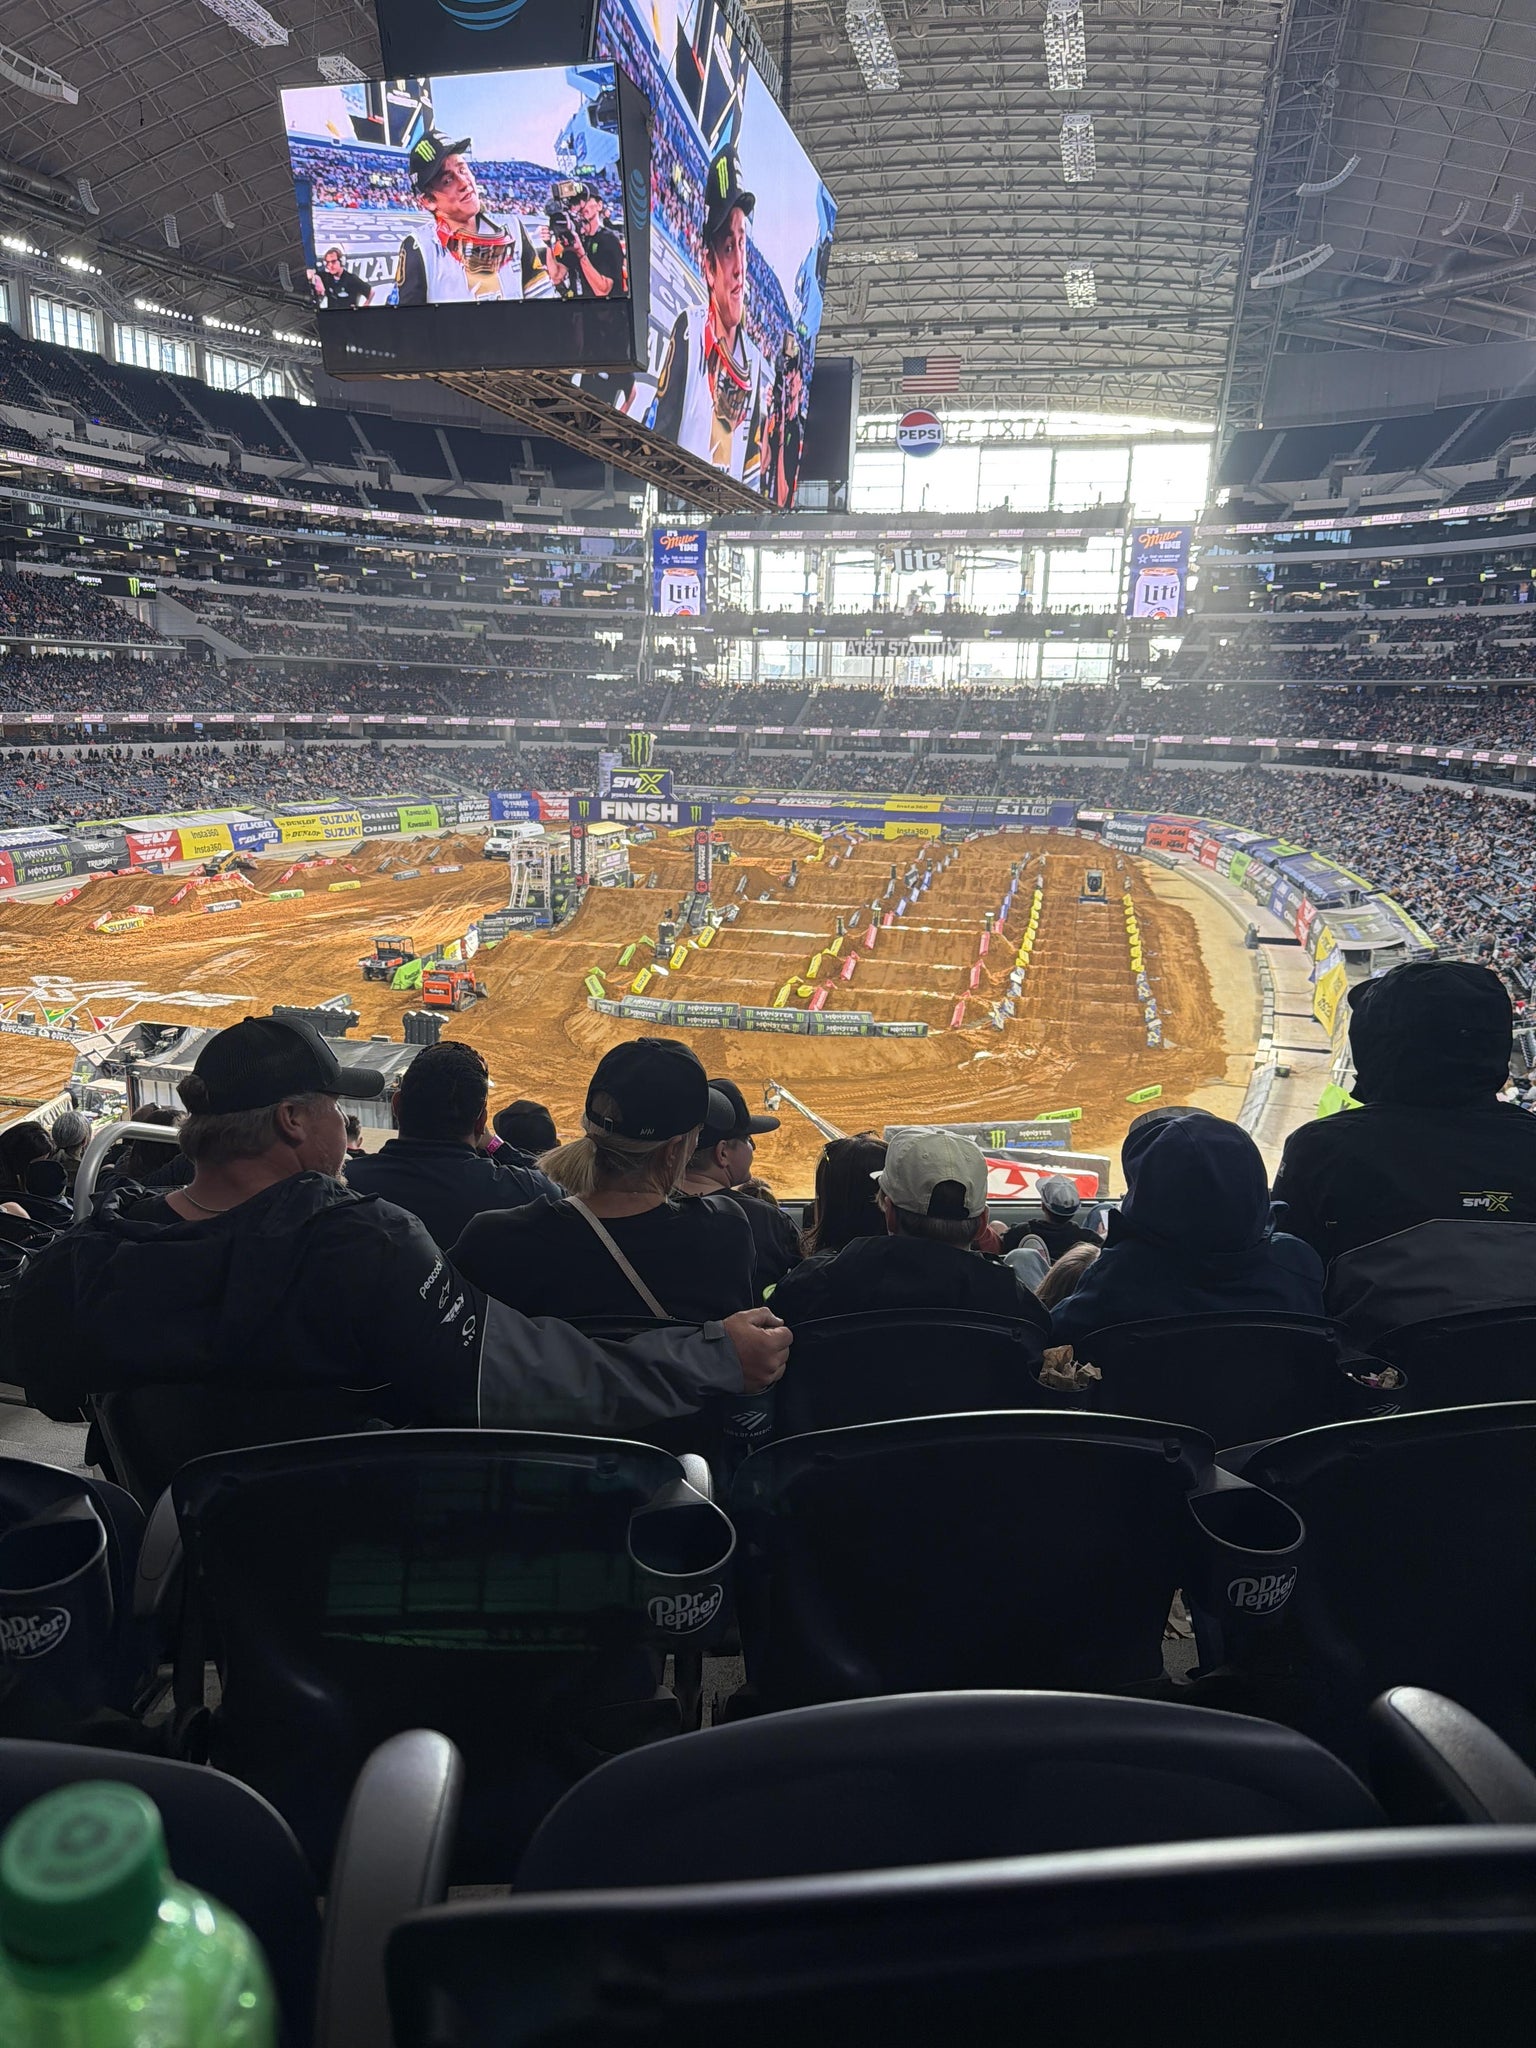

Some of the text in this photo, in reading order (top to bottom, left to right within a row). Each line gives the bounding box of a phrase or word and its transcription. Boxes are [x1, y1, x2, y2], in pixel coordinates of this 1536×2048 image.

[746, 23, 783, 105] STADIUM
[899, 429, 941, 440] PEPSI
[7, 451, 38, 462] MILITARY
[74, 463, 102, 474] MILITARY
[136, 475, 163, 485] MILITARY
[194, 486, 220, 497] MILITARY
[252, 496, 279, 505] MILITARY
[1504, 497, 1534, 507] MILITARY
[311, 503, 338, 511] MILITARY
[1438, 506, 1469, 515] MILITARY
[433, 517, 461, 525] MILITARY
[1304, 519, 1336, 527] MILITARY
[1371, 513, 1402, 522] MILITARY
[1236, 523, 1267, 531] MILITARY
[660, 534, 699, 550] Miller
[1138, 531, 1182, 549] Miller
[1159, 541, 1181, 549] TIME
[680, 543, 698, 551] TIME
[1144, 585, 1177, 605] Lite
[845, 641, 961, 656] AT&T STADIUM
[611, 773, 665, 794] SMX
[601, 801, 678, 822] FINISH
[995, 805, 1031, 816] 5.11
[319, 811, 360, 825] SUZUKI
[234, 821, 272, 832] FALKEN
[407, 820, 433, 829] Kawasaki
[191, 829, 219, 839] Insta360
[324, 826, 362, 838] SUZUKI
[897, 827, 928, 836] Insta360
[239, 831, 278, 845] FALKEN
[23, 847, 60, 859] MONSTER
[194, 843, 222, 854] Insta360
[27, 864, 64, 877] MONSTER
[109, 920, 141, 932] SUZUKI
[687, 1005, 724, 1013] MONSTER
[756, 1010, 794, 1018] MONSTER
[687, 1016, 720, 1024] MONSTER
[825, 1013, 860, 1021] MONSTER
[756, 1021, 790, 1030] MONSTER
[1462, 1194, 1510, 1212] SMX
[1260, 1574, 1286, 1593] Dr
[1227, 1574, 1295, 1610] Pepper
[675, 1592, 703, 1612] Dr
[648, 1592, 719, 1630] Pepper
[9, 1616, 40, 1636] Dr
